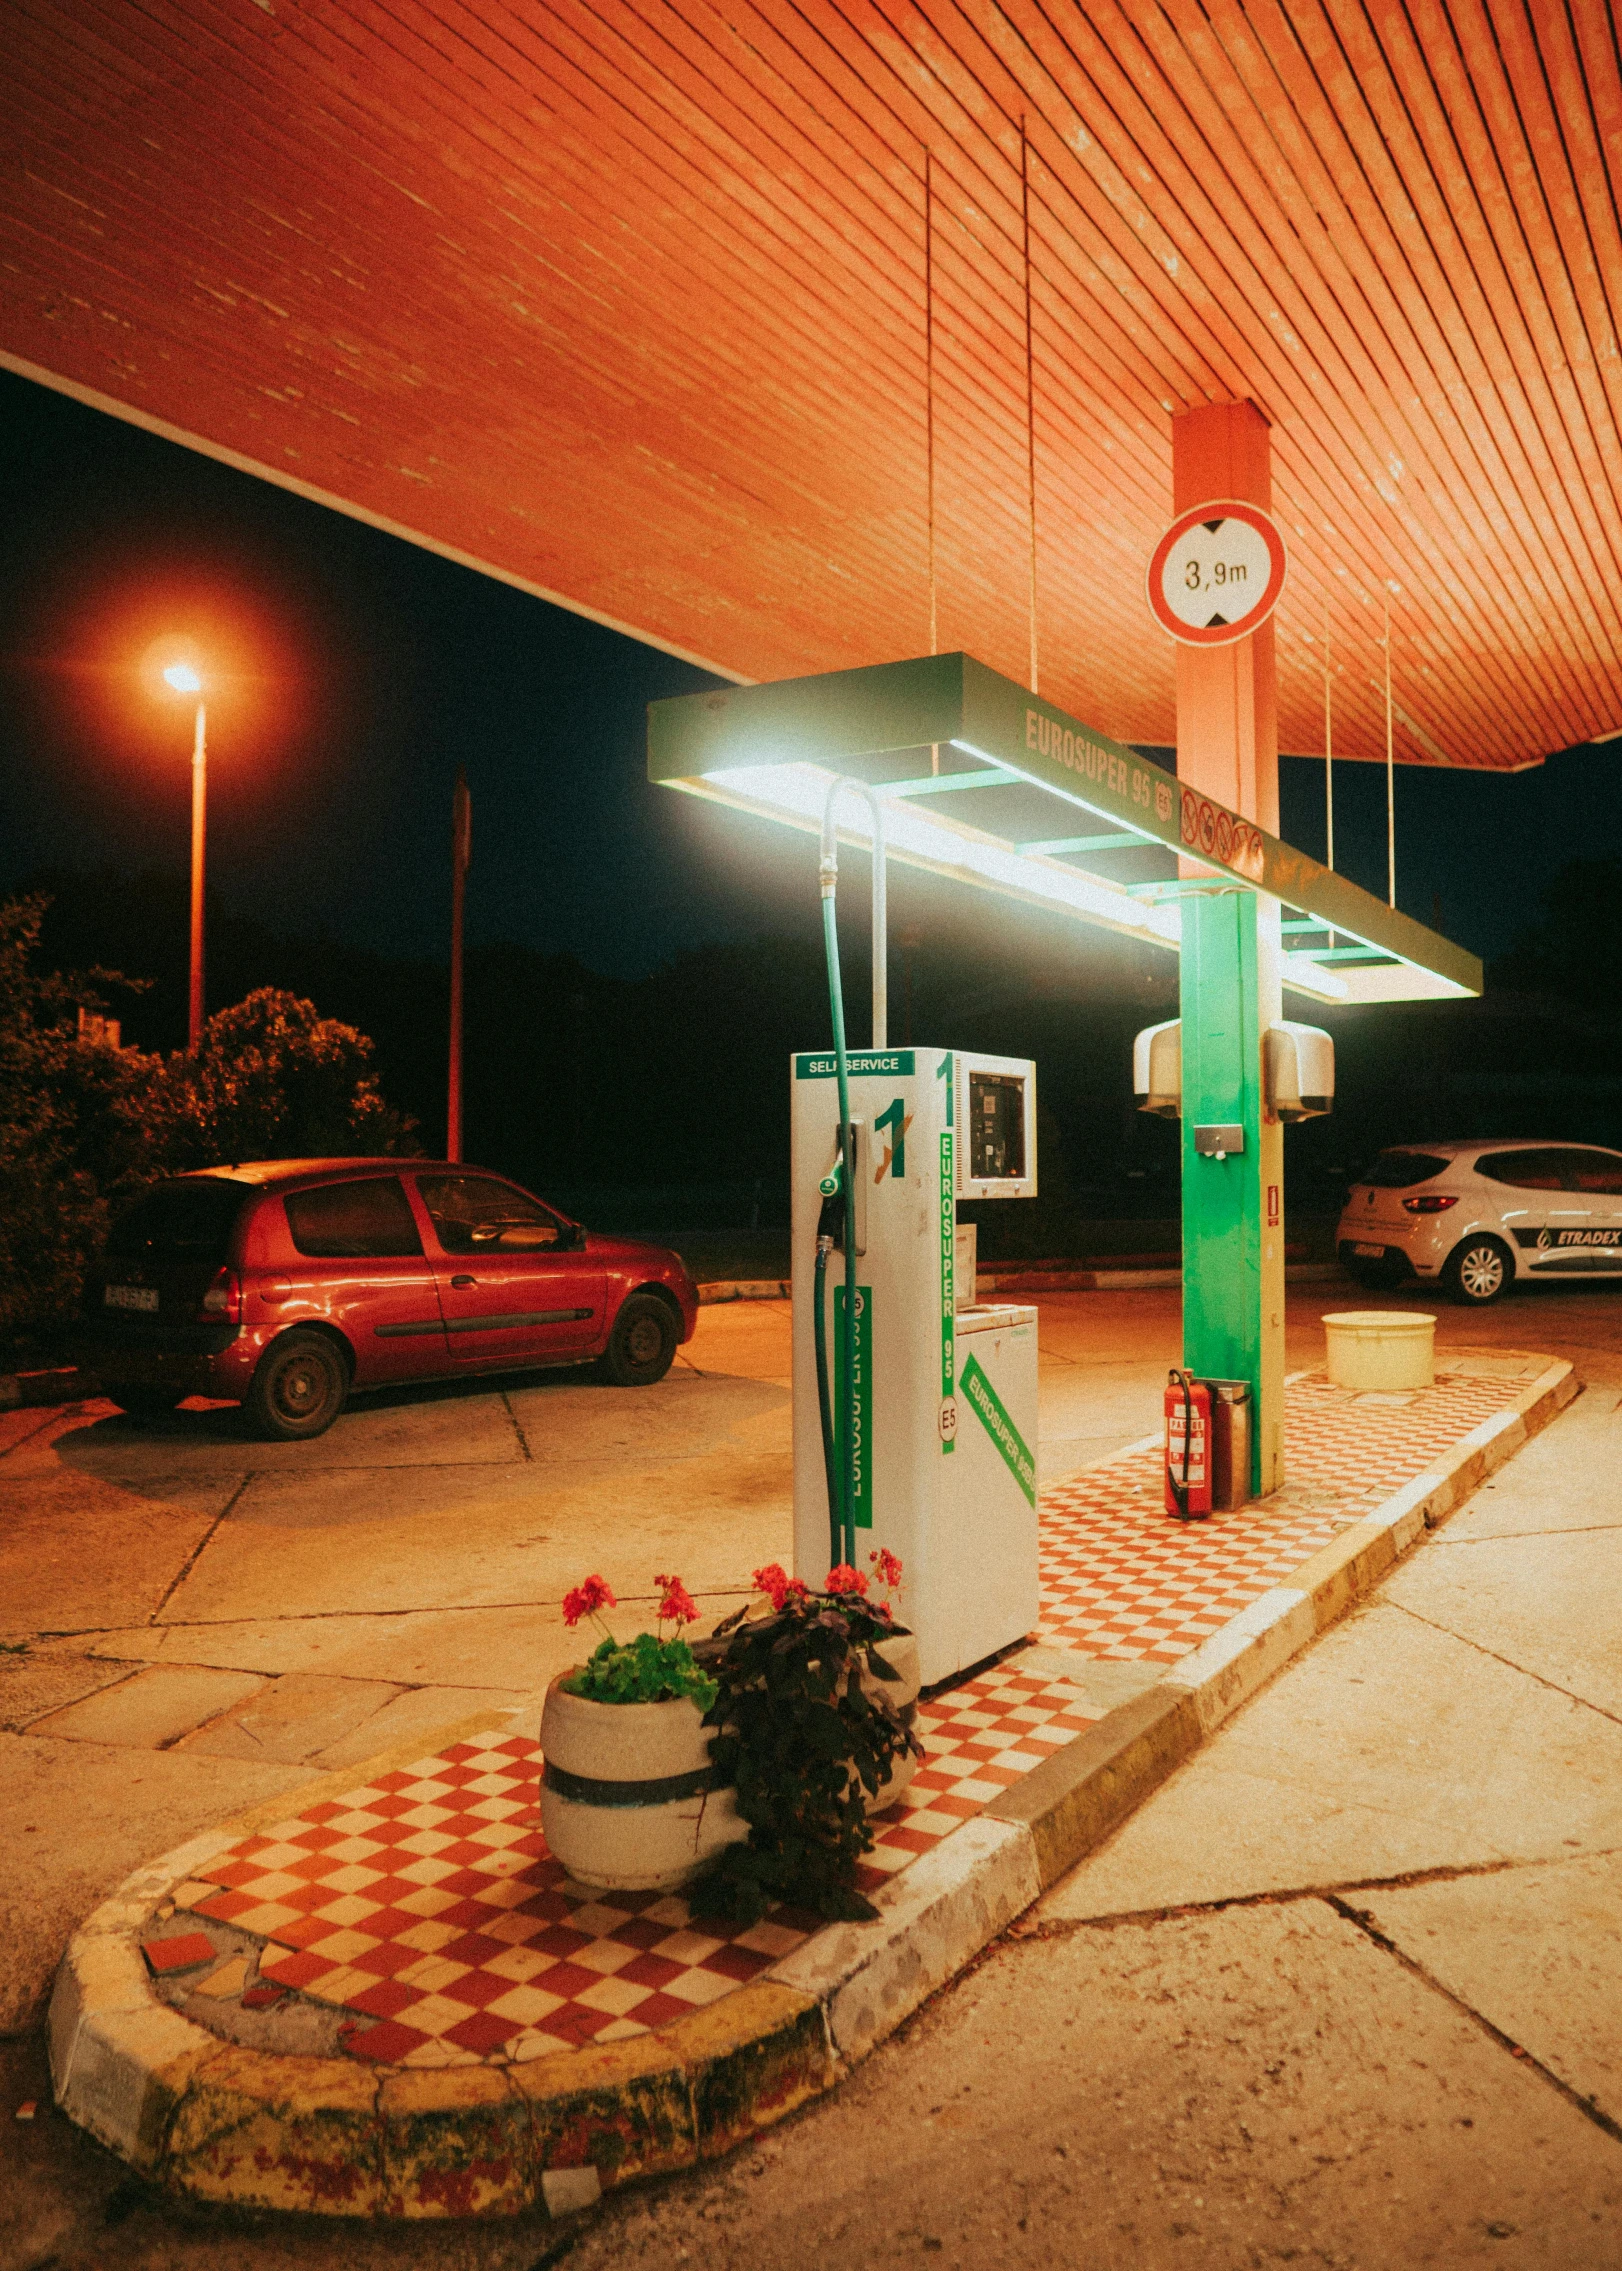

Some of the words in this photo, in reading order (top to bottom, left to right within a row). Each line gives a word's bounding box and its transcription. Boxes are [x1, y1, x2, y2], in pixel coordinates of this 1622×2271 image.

[1185, 560, 1248, 592] 3,9m
[1025, 708, 1128, 796] EUROSUPER
[1132, 769, 1151, 808] 95
[845, 1058, 900, 1071] SERVICE
[935, 1051, 954, 1127] 1
[874, 1098, 904, 1178] 1
[942, 1137, 952, 1318] EUROSUPER
[1558, 1231, 1622, 1245] ETRADEX
[944, 1339, 952, 1379] 95
[942, 1408, 956, 1430] E5
[969, 1374, 1020, 1464] EUROSUPER
